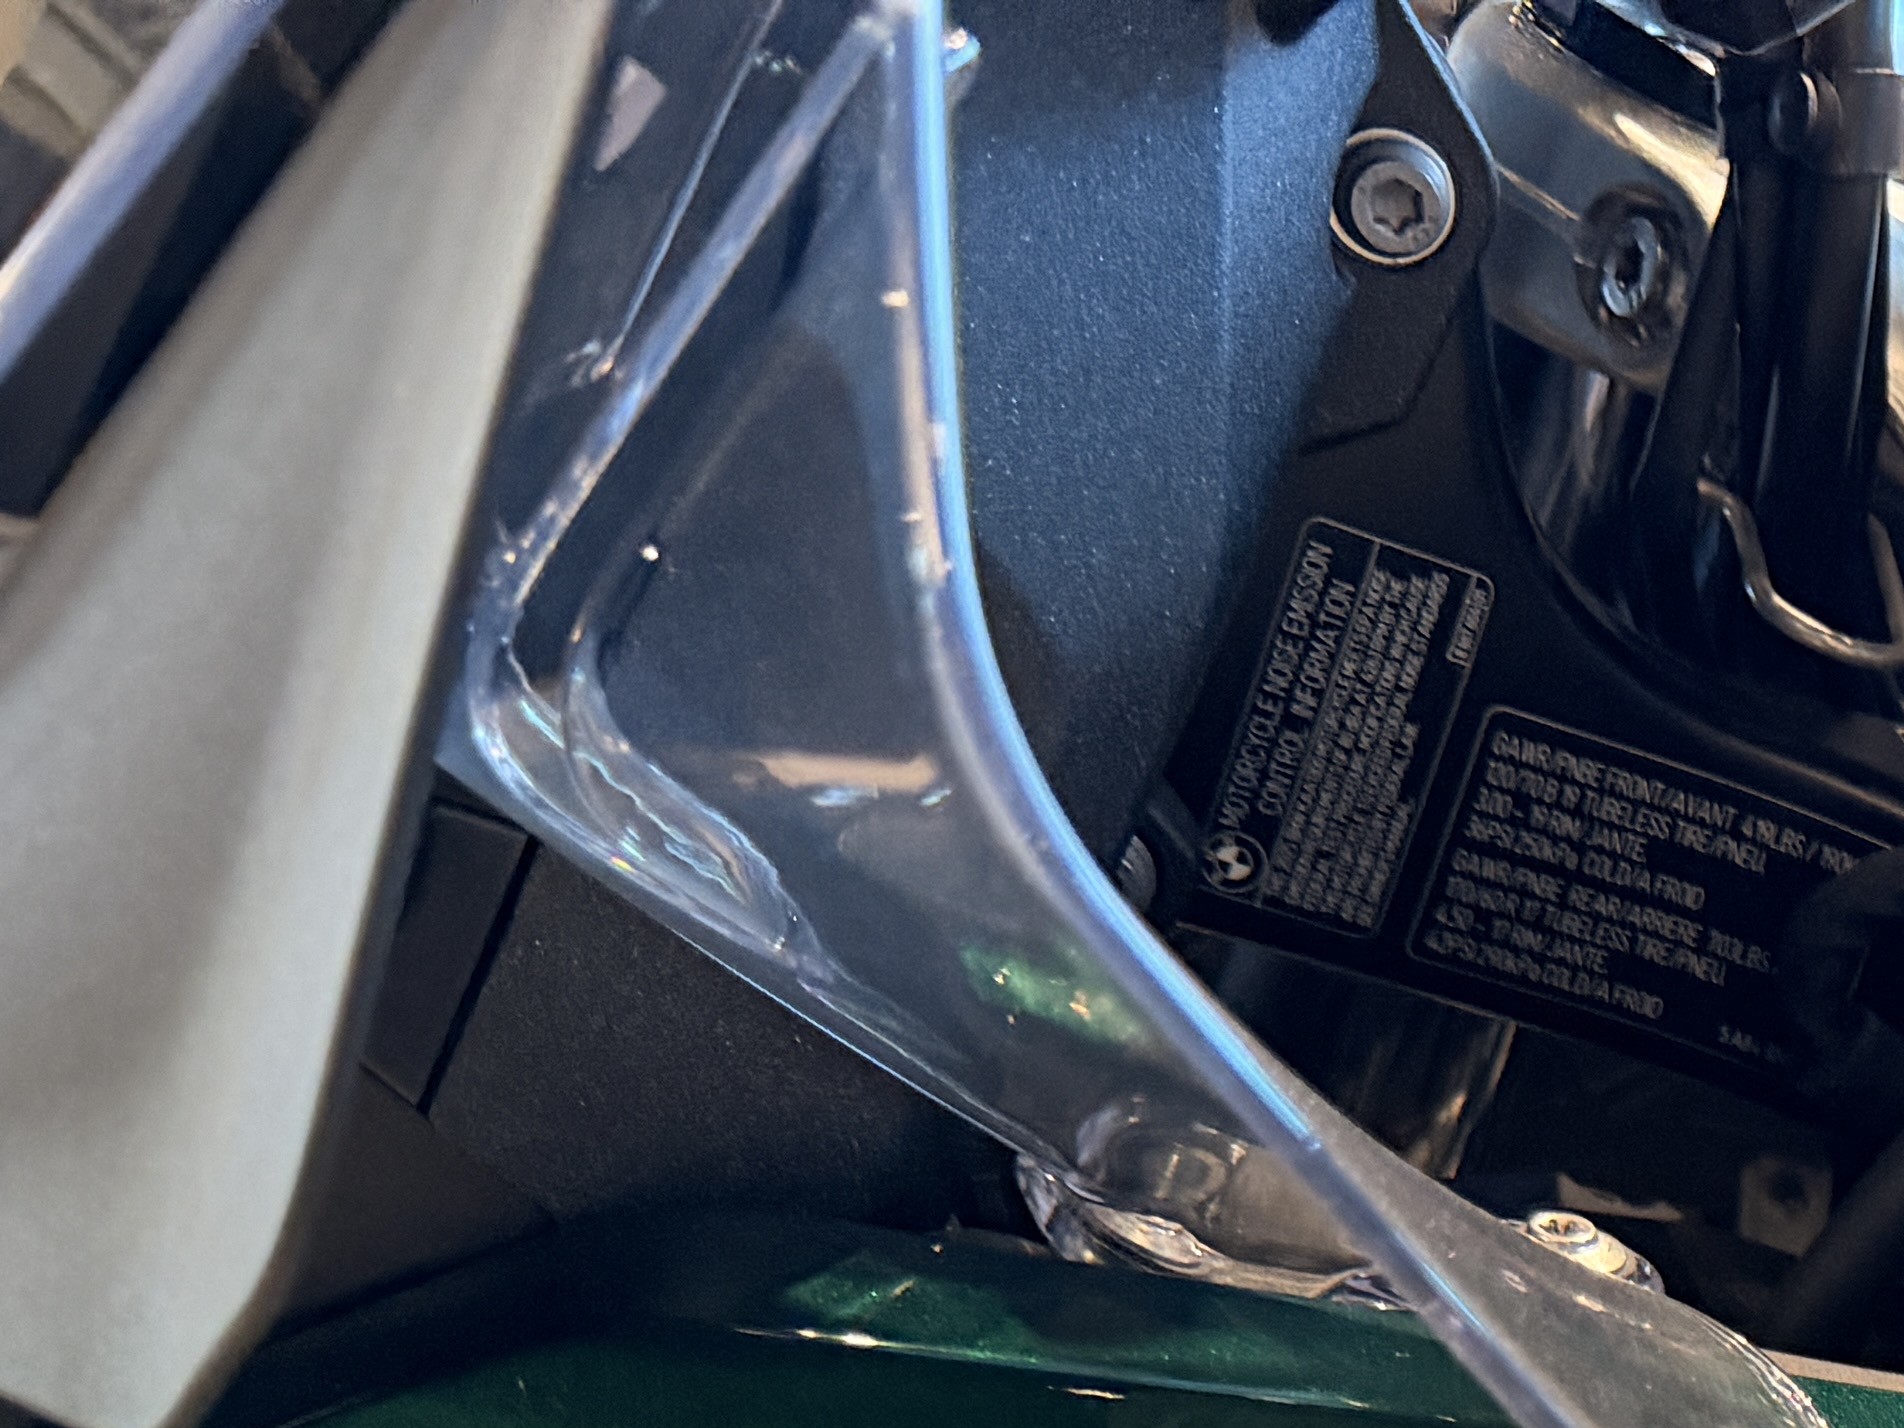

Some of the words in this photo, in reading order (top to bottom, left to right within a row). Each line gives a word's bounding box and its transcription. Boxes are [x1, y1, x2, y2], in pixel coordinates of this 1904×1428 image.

[1281, 540, 1333, 636] EMISSION
[1257, 728, 1306, 816] CONTROL
[1290, 578, 1356, 719] INFORMATION
[1262, 634, 1304, 697] NOISE
[1218, 693, 1284, 828] MOTORCYCLE
[1584, 789, 1672, 839] TUBELESS
[1604, 767, 1738, 829] FRONT/AVANT
[1544, 904, 1632, 952] TUBELESS
